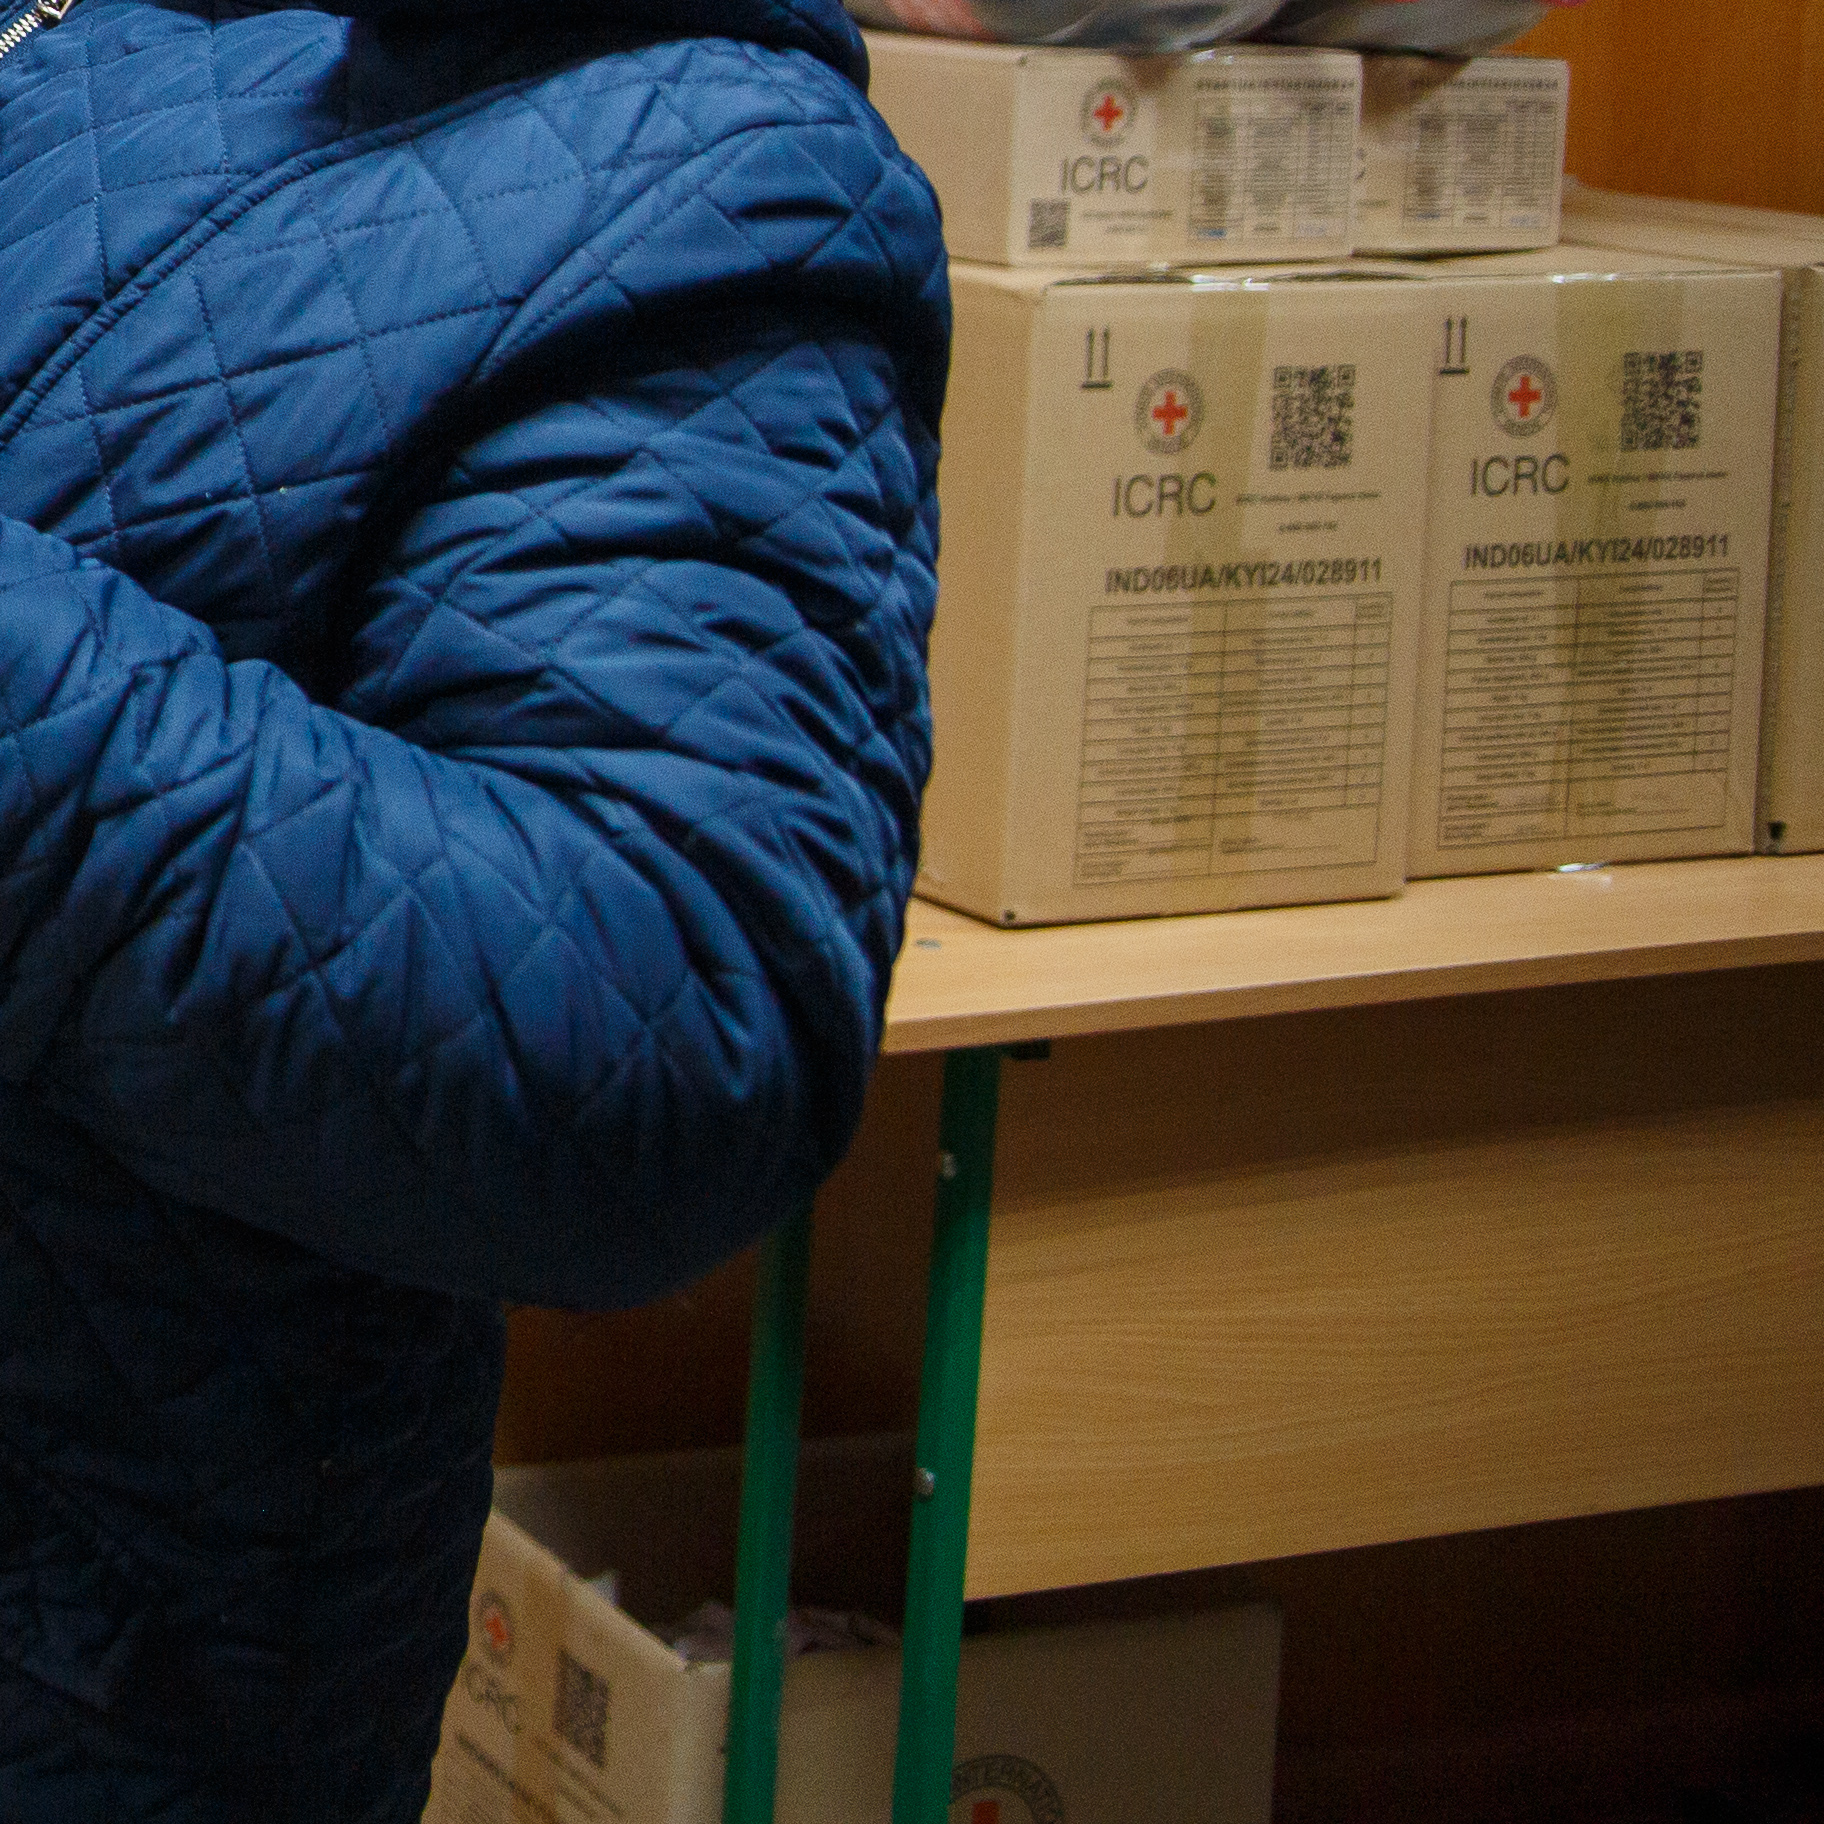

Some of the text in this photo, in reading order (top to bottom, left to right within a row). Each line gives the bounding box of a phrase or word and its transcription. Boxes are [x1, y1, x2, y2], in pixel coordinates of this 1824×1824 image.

[1059, 154, 1150, 195] ICRC
[1111, 472, 1217, 517] ICRC
[1470, 453, 1570, 498] ICRC
